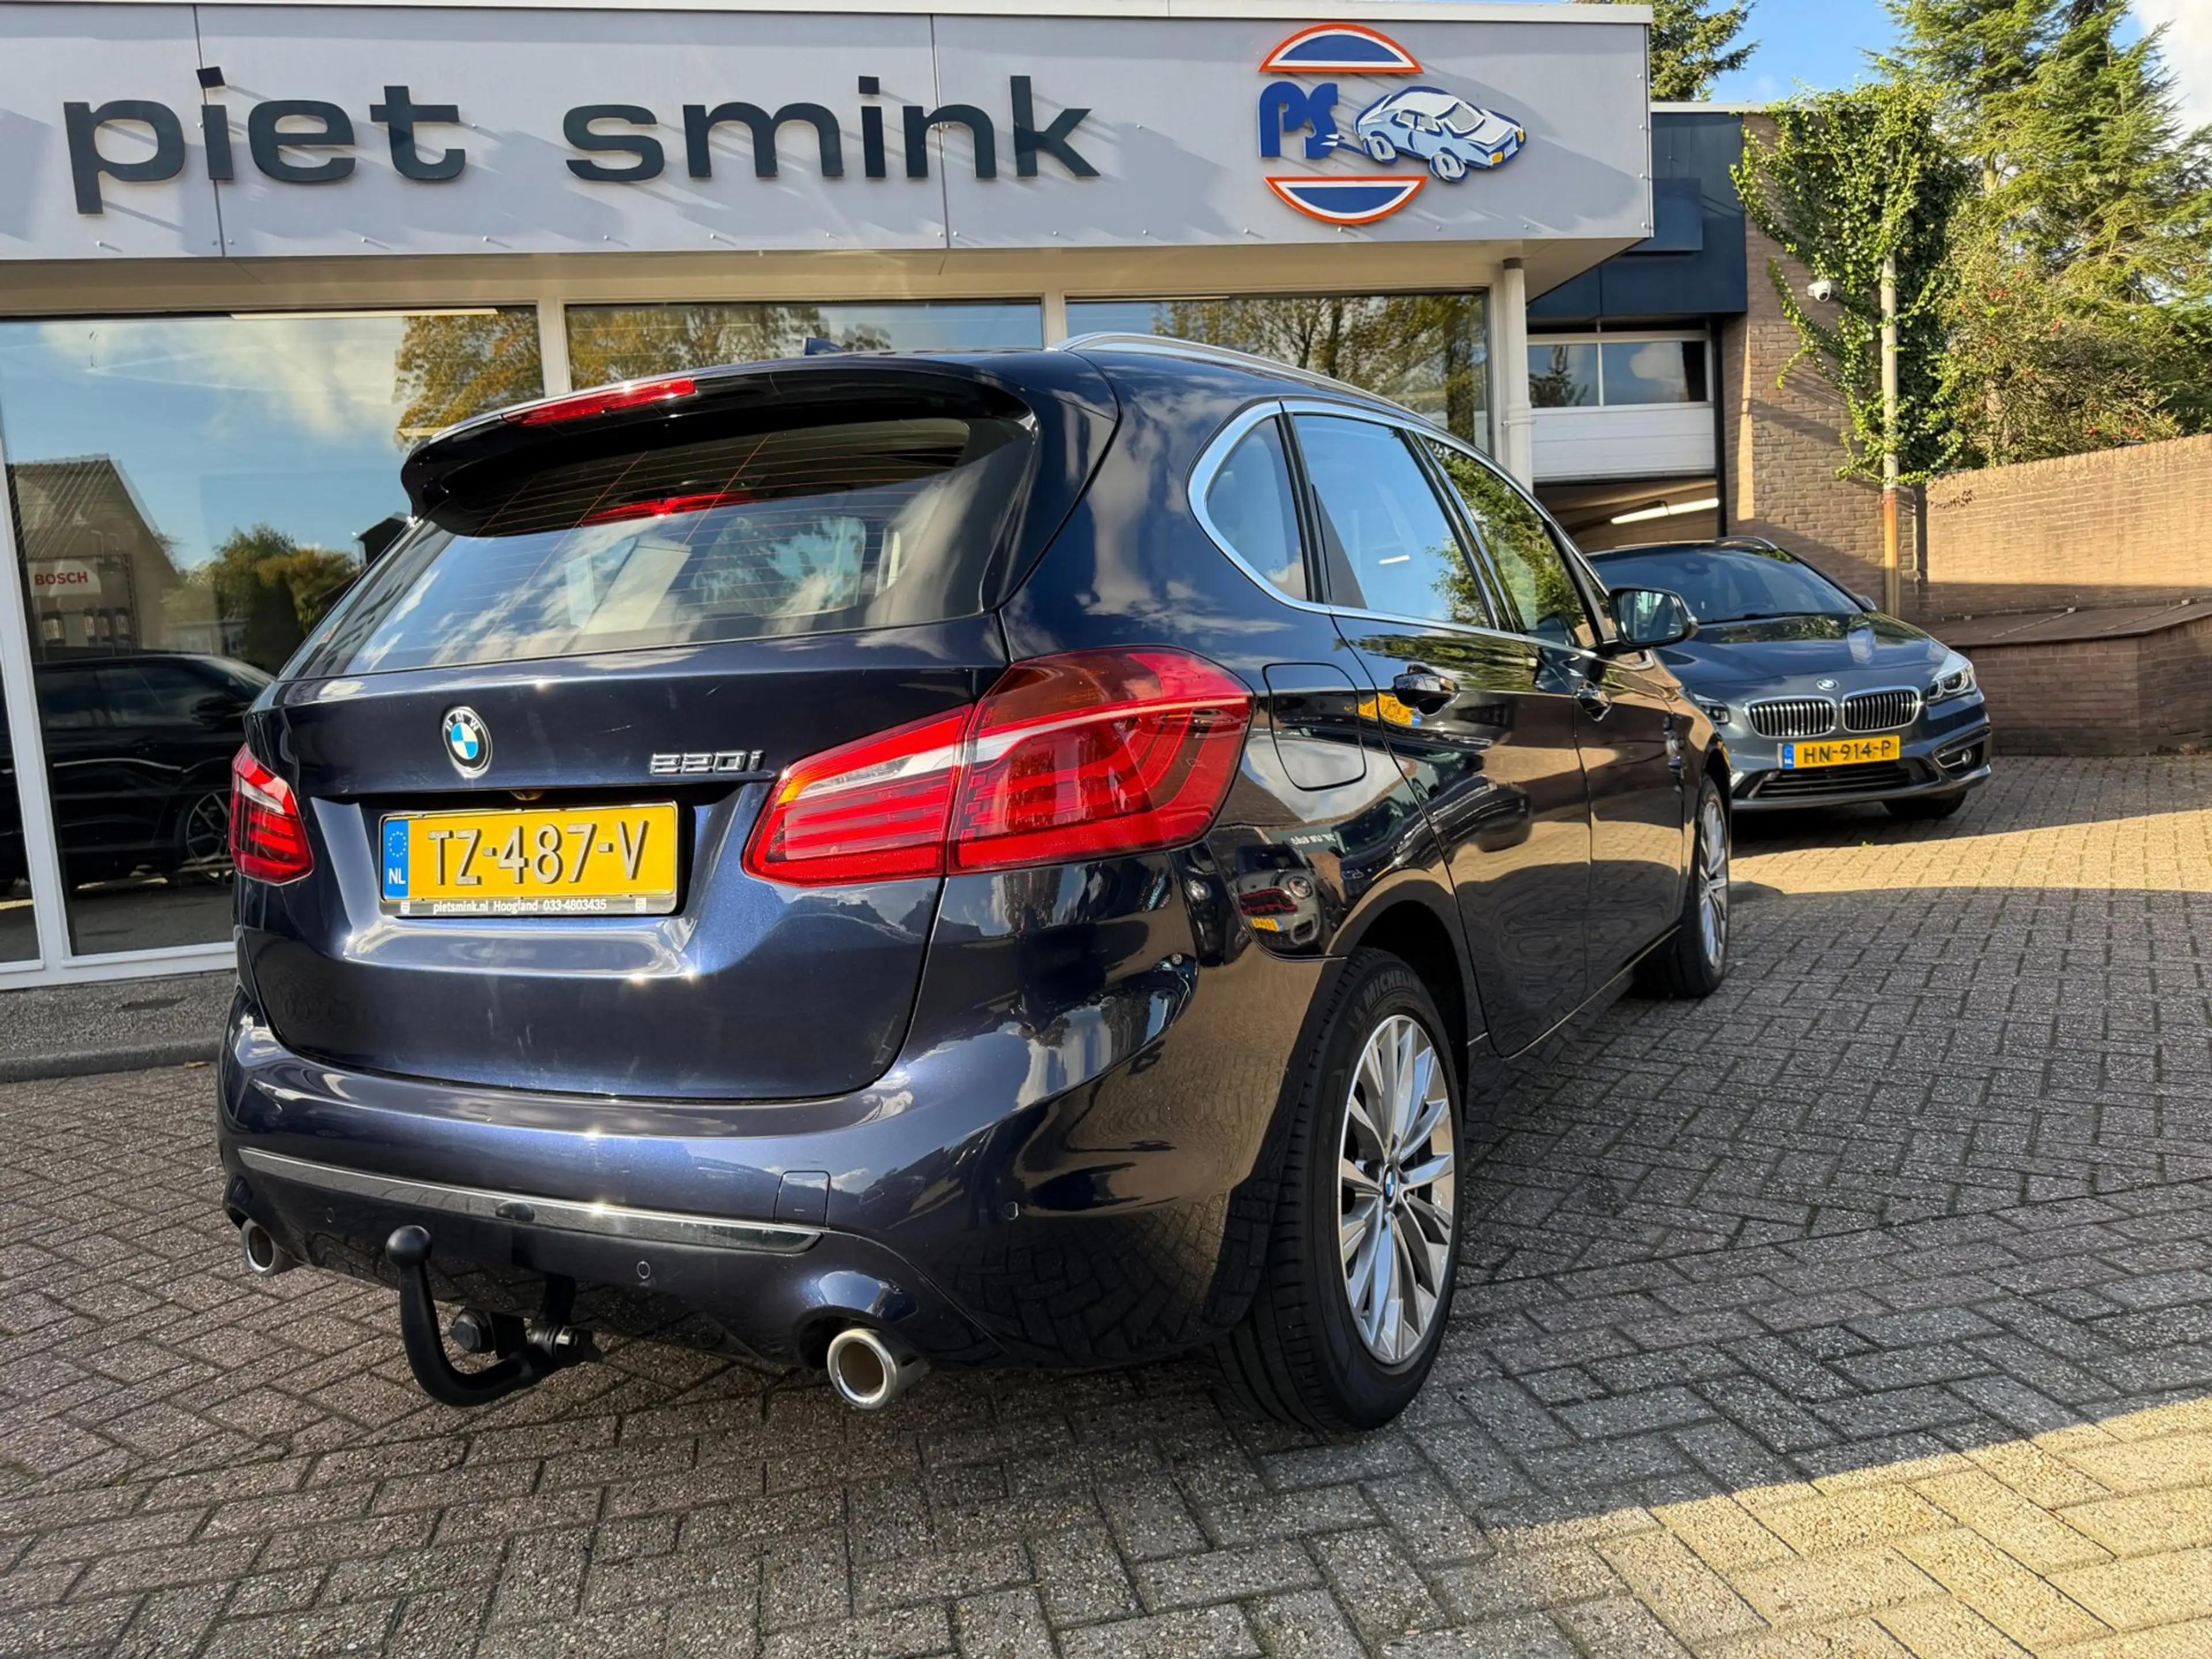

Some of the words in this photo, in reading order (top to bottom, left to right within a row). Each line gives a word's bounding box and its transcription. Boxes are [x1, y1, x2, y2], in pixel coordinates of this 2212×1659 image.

[63, 66, 465, 214] piet
[563, 75, 1099, 181] smink
[35, 571, 88, 585] BOSCH
[446, 712, 480, 732] BMW
[649, 750, 764, 775] 220i
[1804, 740, 1892, 764] HN-914-P
[427, 820, 650, 886] TZ-487-V
[389, 868, 406, 885] NL
[493, 899, 539, 914] Hoogland
[543, 898, 607, 912] 033-4803435
